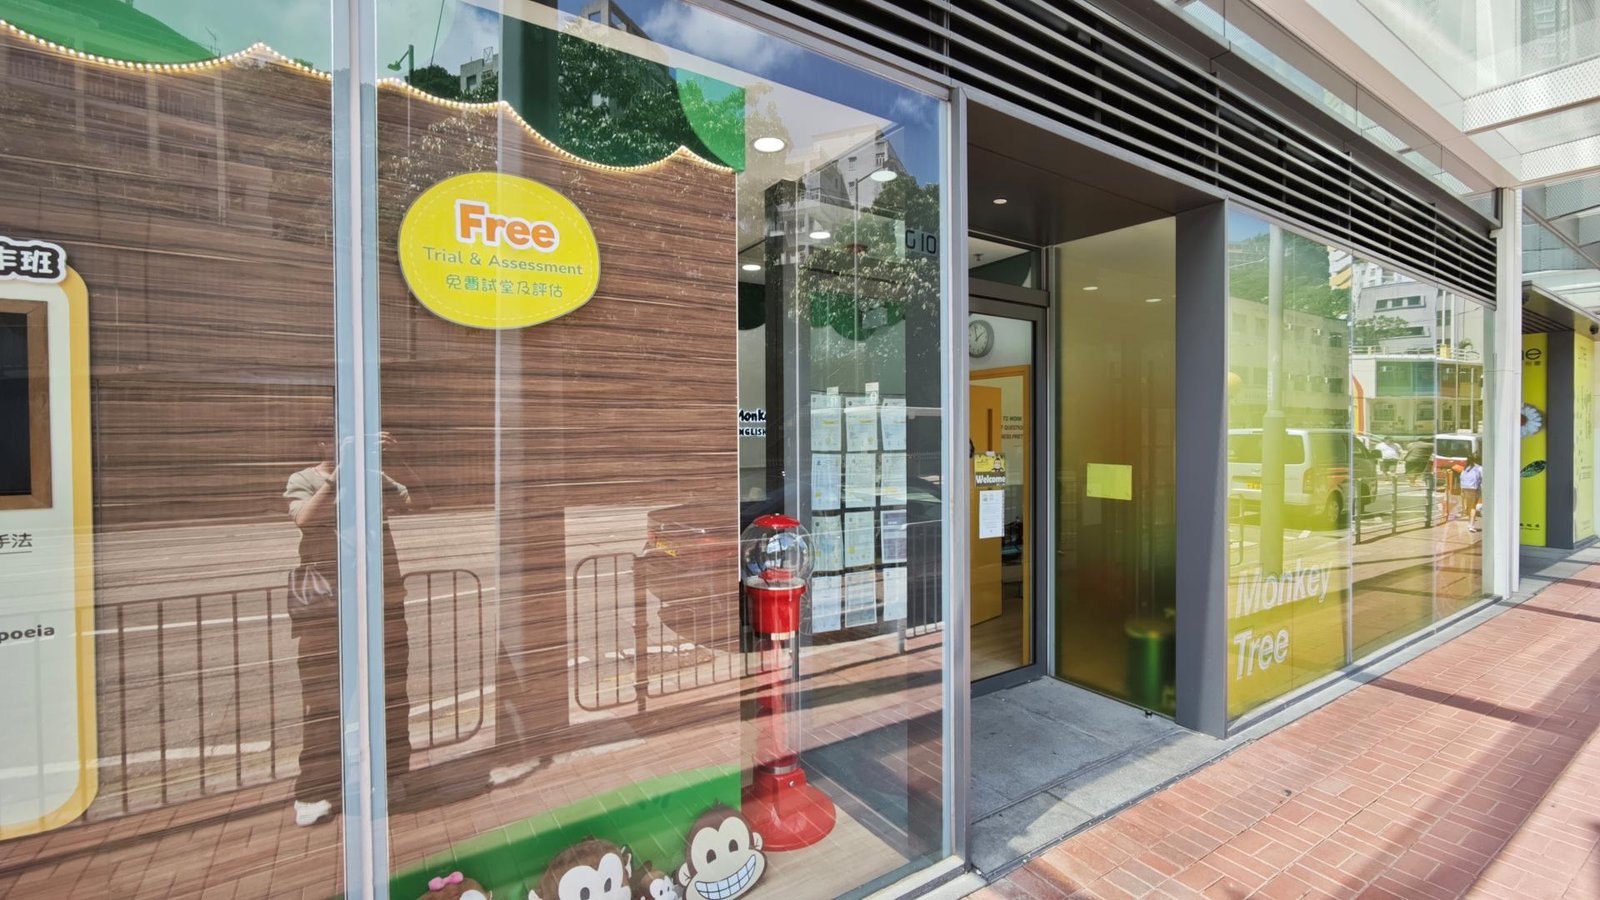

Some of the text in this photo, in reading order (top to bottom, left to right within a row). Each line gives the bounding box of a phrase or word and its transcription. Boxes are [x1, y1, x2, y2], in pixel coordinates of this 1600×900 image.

[457, 201, 558, 251] Free
[423, 246, 584, 276] Trial & Assessment
[446, 273, 564, 298] 免費試堂及評估
[975, 474, 1006, 484] Welcome
[1235, 558, 1333, 619] Monkey
[1233, 629, 1290, 681] Tree
